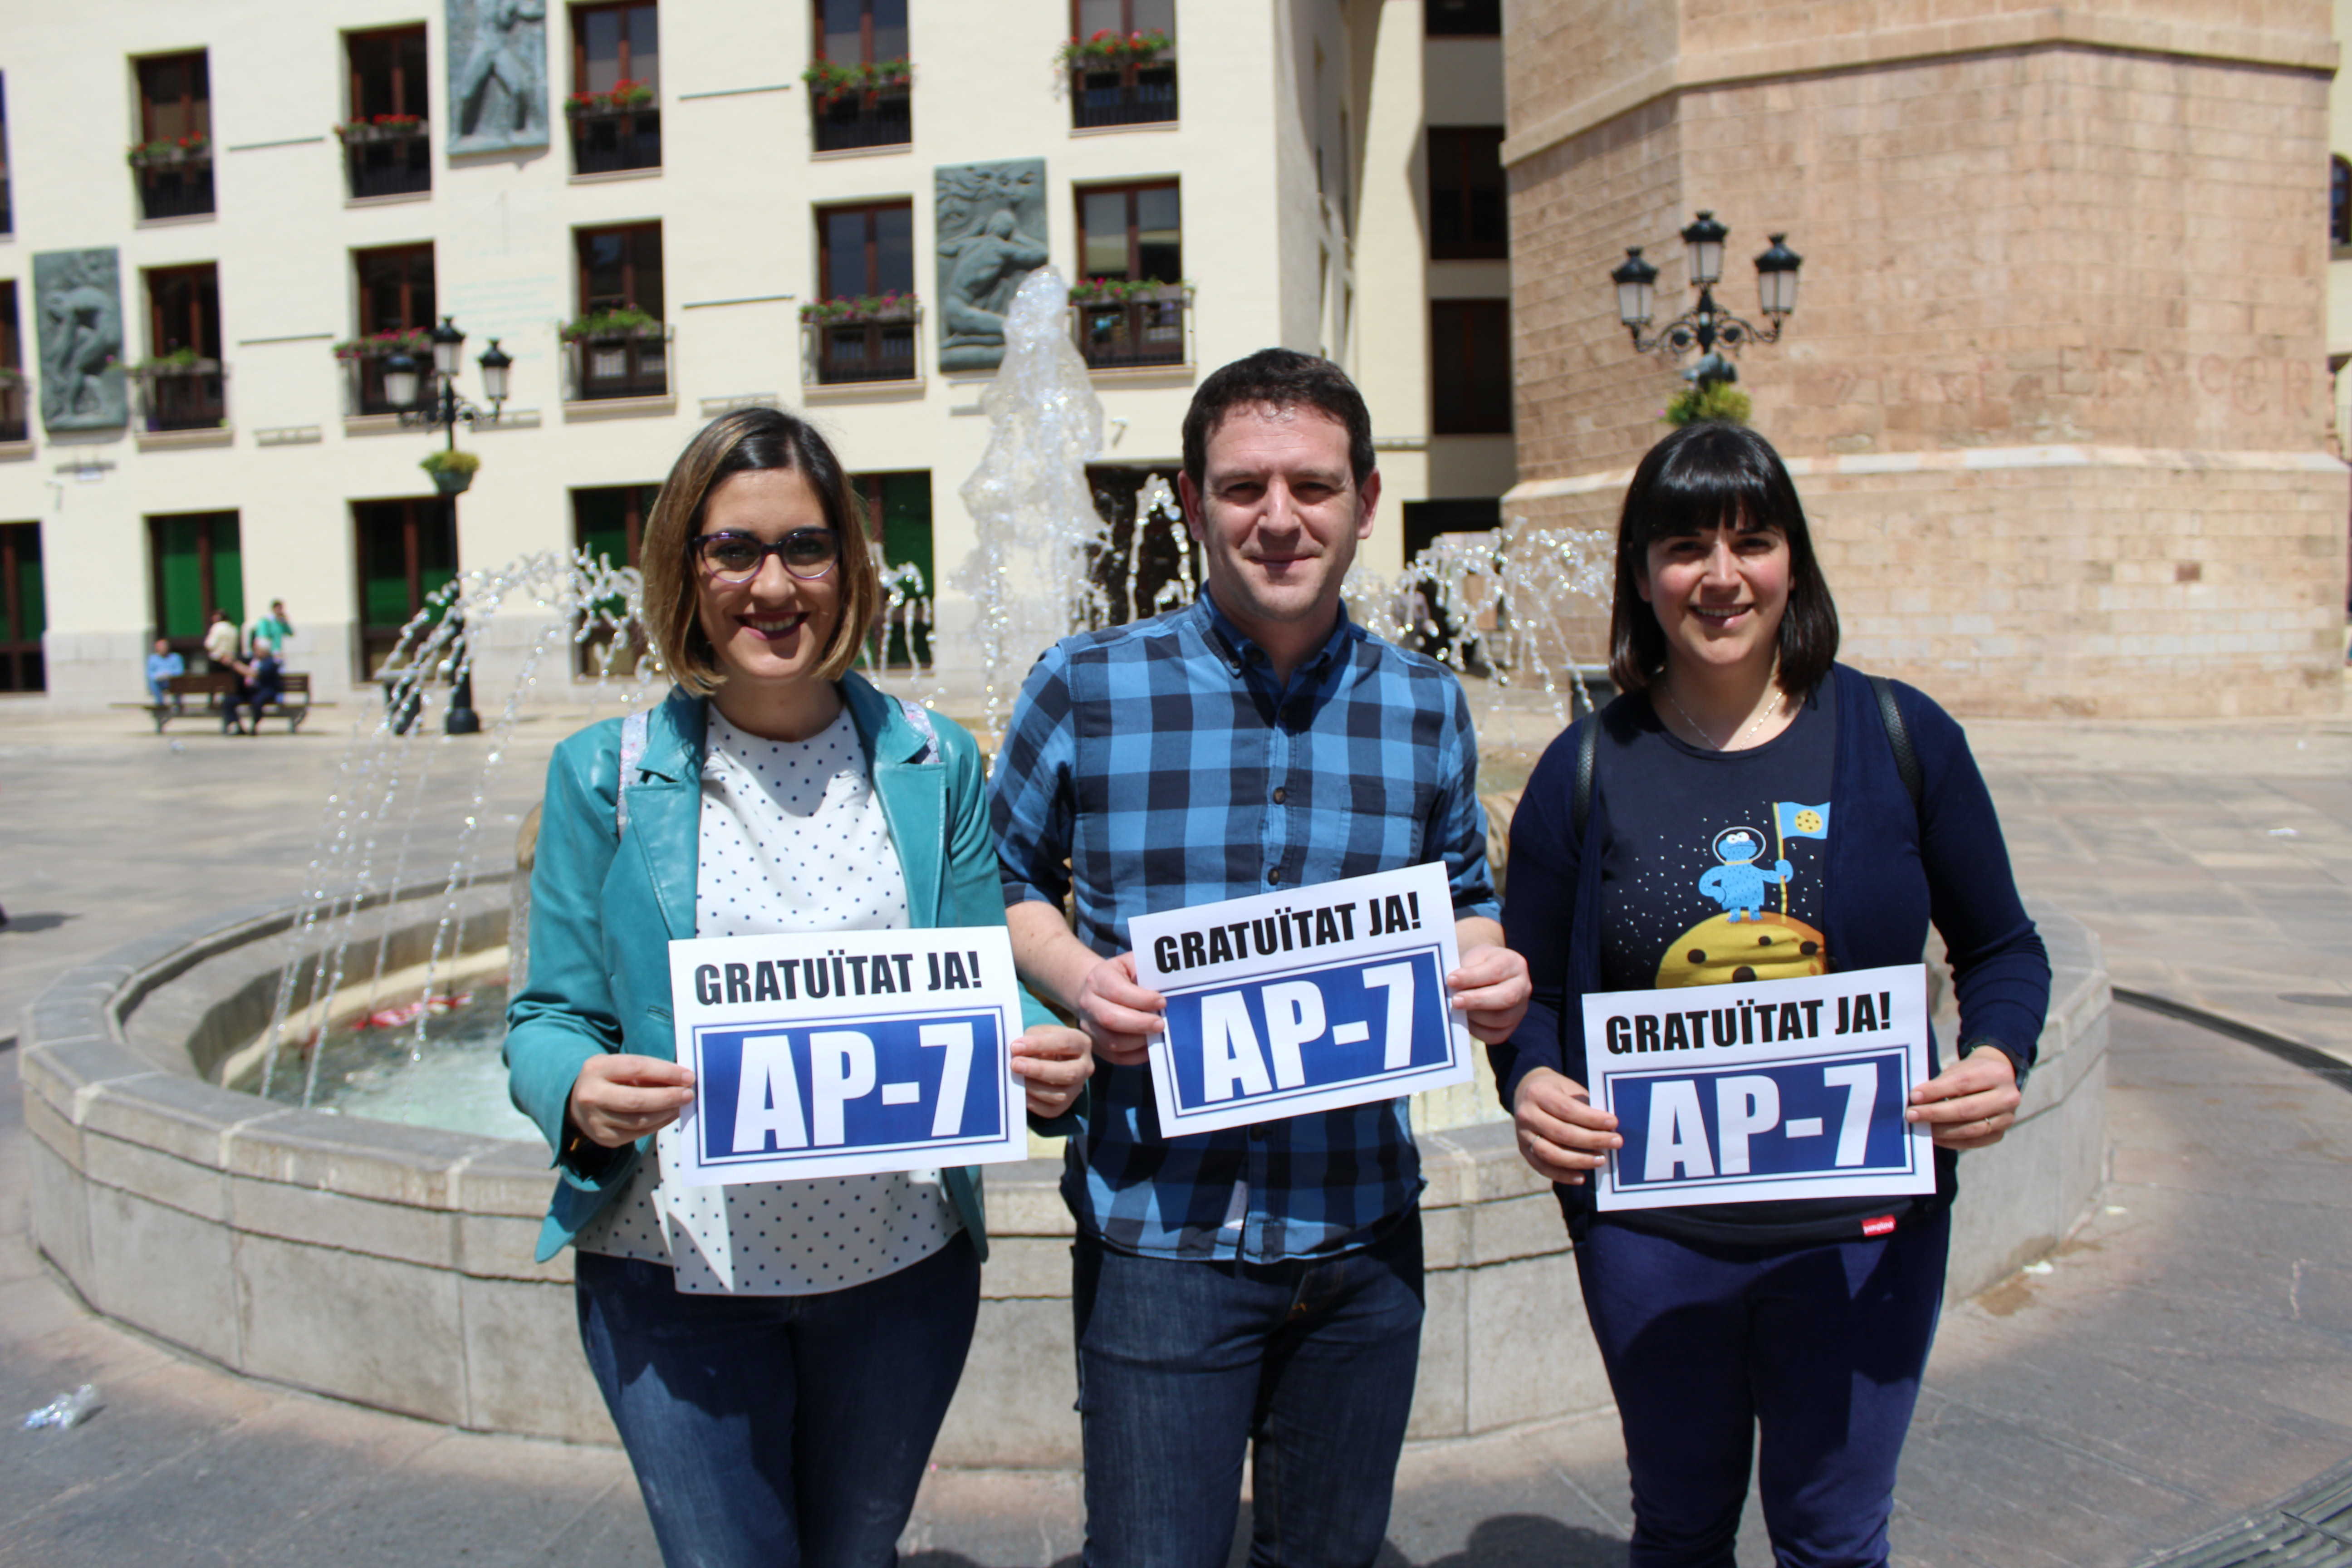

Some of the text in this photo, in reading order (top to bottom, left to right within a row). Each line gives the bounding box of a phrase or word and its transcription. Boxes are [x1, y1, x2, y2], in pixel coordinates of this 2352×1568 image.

[696, 950, 981, 1005] GRATUÏTAT JA!
[1155, 892, 1421, 973] GRATUÏTAT JA!
[1201, 962, 1415, 1102] AP-7
[1607, 992, 1890, 1054] GRATUÏTAT JA!
[732, 1022, 974, 1152] AP-7
[1645, 1063, 1878, 1181] AP-7
